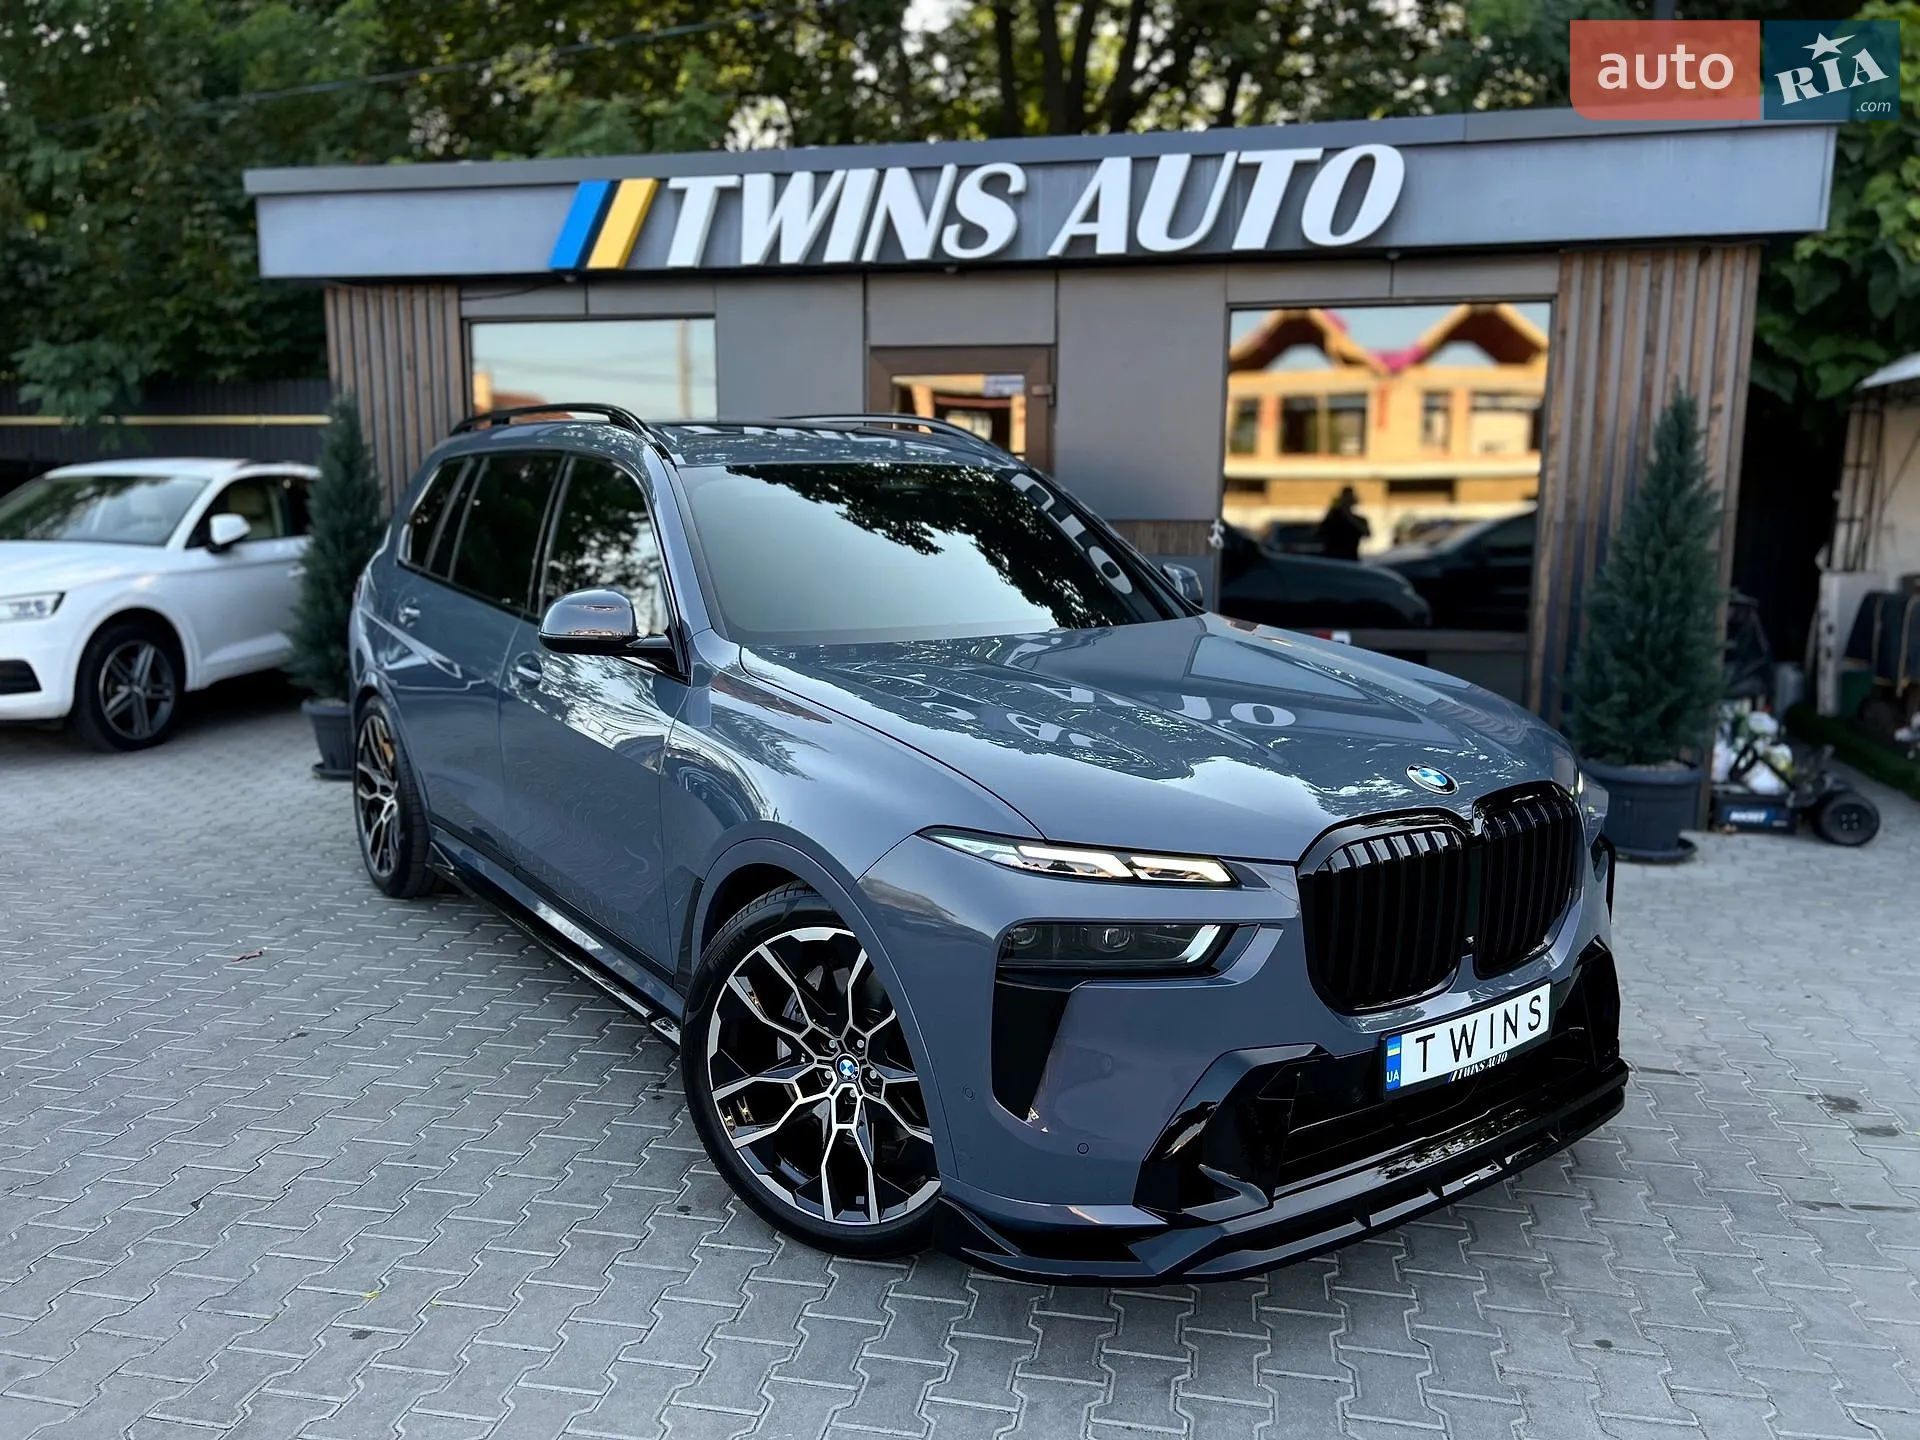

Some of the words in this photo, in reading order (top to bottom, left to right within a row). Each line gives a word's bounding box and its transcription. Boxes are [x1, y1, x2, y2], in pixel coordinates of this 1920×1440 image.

[666, 162, 1027, 268] TWINS
[1046, 143, 1405, 256] AUTO
[1415, 994, 1542, 1073] TWINS
[1386, 1068, 1400, 1083] UA
